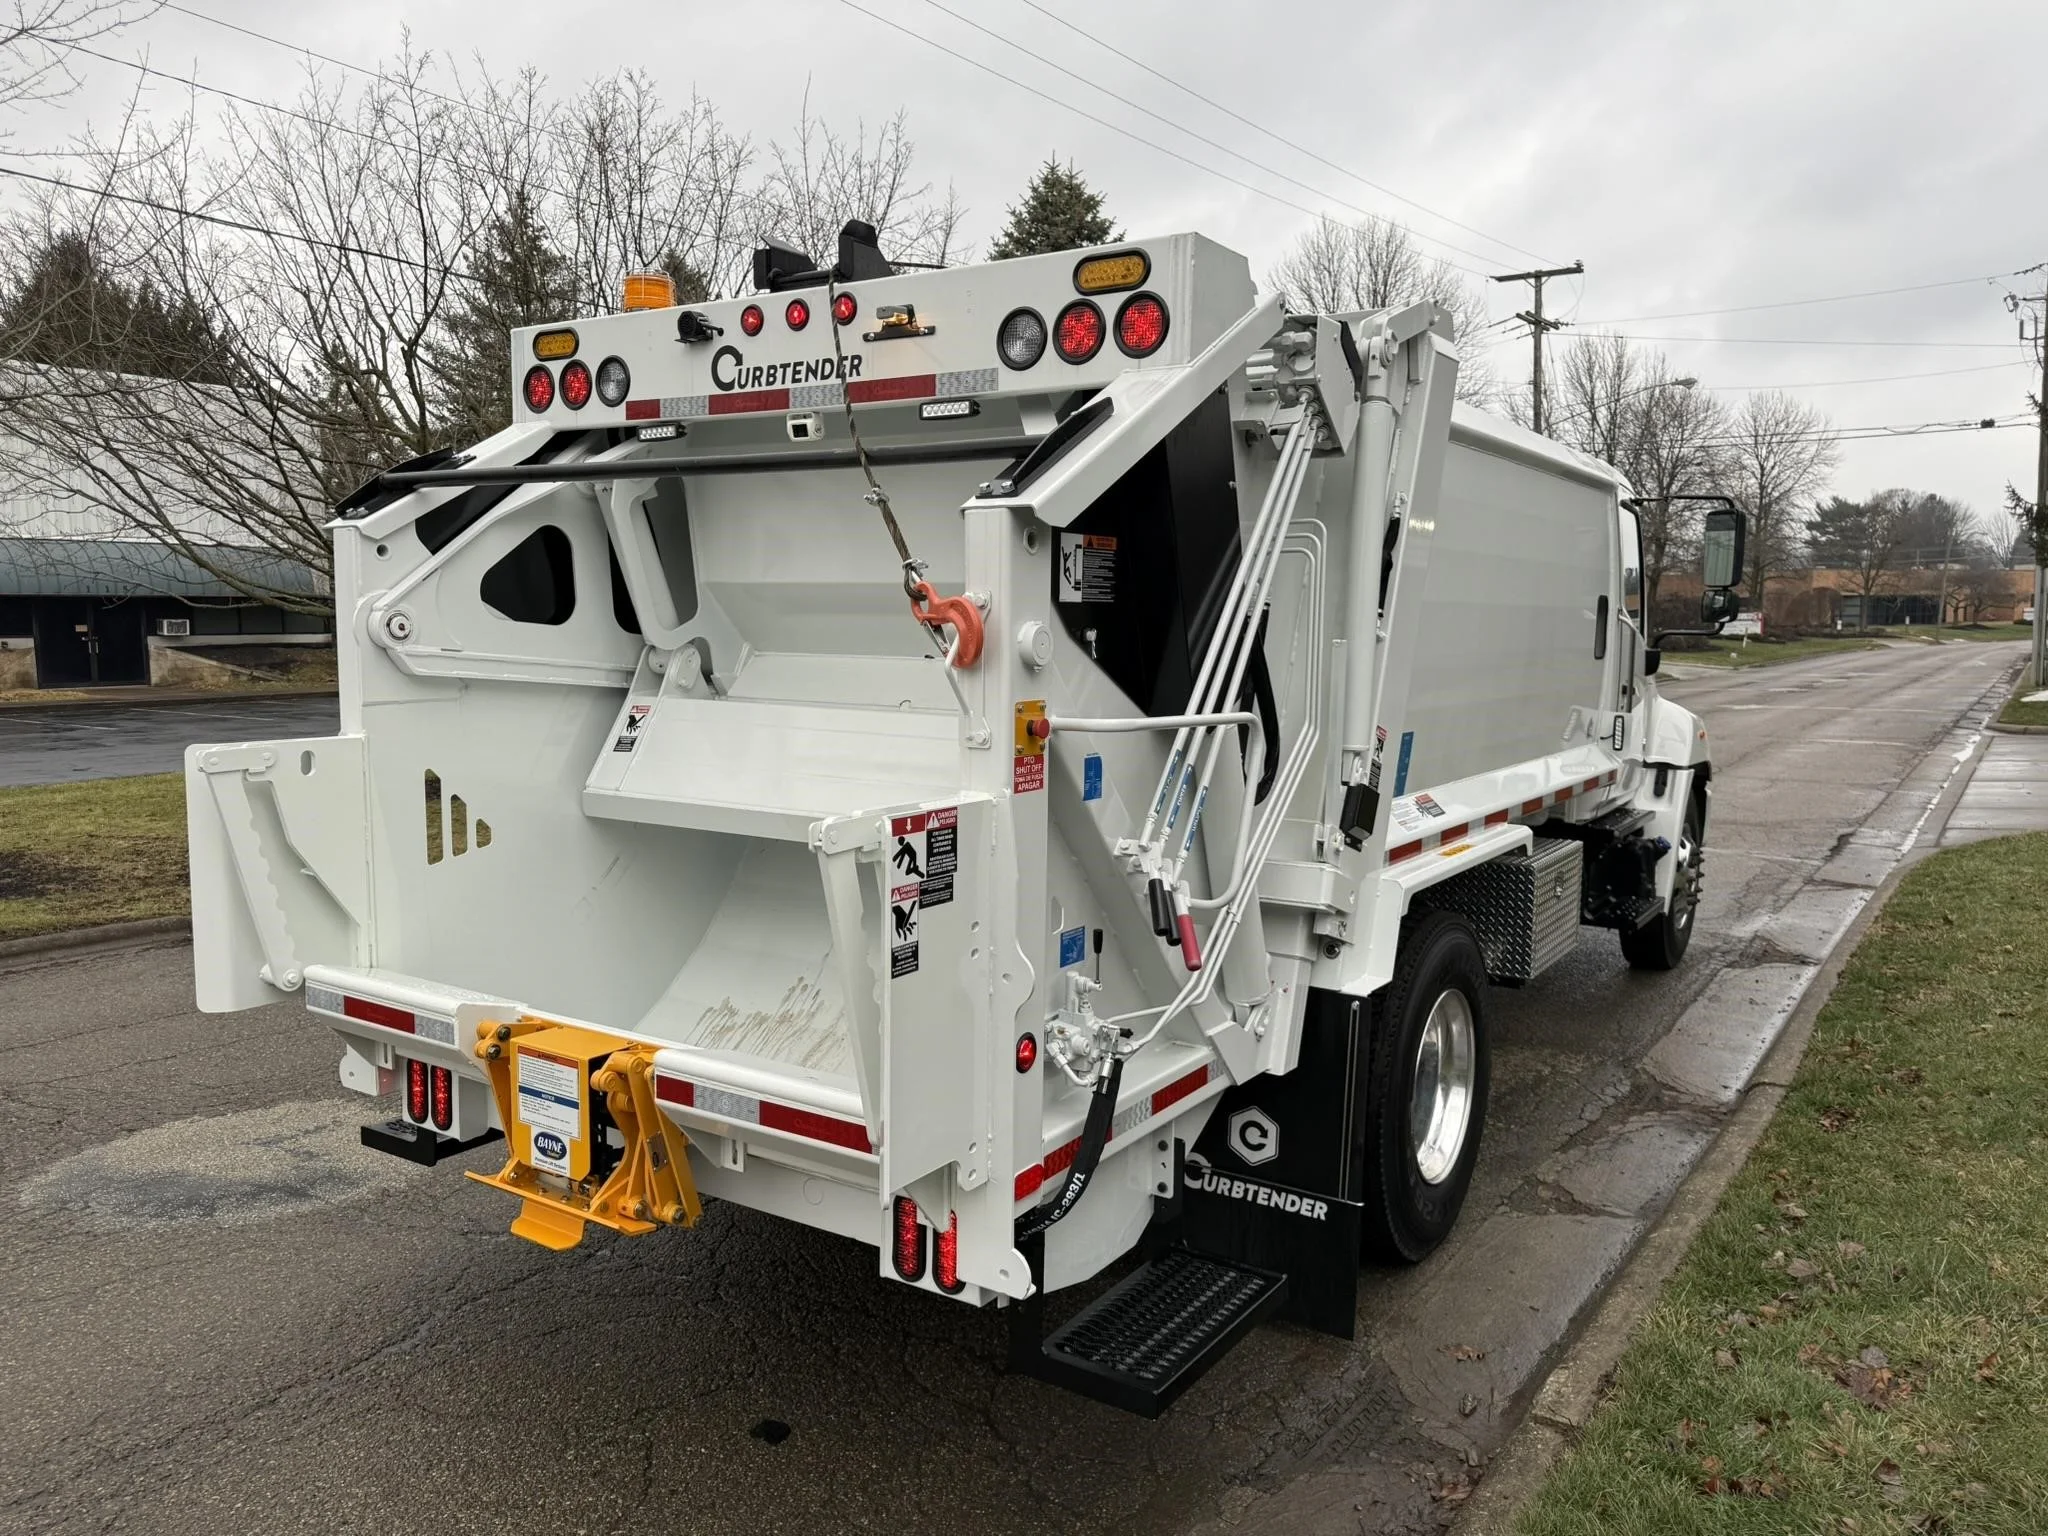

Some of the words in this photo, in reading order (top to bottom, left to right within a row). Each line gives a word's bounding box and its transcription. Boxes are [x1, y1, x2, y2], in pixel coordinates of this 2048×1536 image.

[712, 345, 862, 391] CURBTENDER
[1024, 756, 1035, 764] PTO
[1016, 765, 1031, 774] SHUT
[1031, 764, 1042, 772] OFF
[1018, 781, 1040, 791] APAGAR
[937, 809, 957, 818] DANGER
[939, 817, 956, 825] PELIGRO
[900, 883, 918, 893] DANGER
[901, 890, 918, 900] PELIGRO
[537, 1136, 563, 1153] BAYNE
[1184, 1152, 1328, 1221] CURBTENDER
